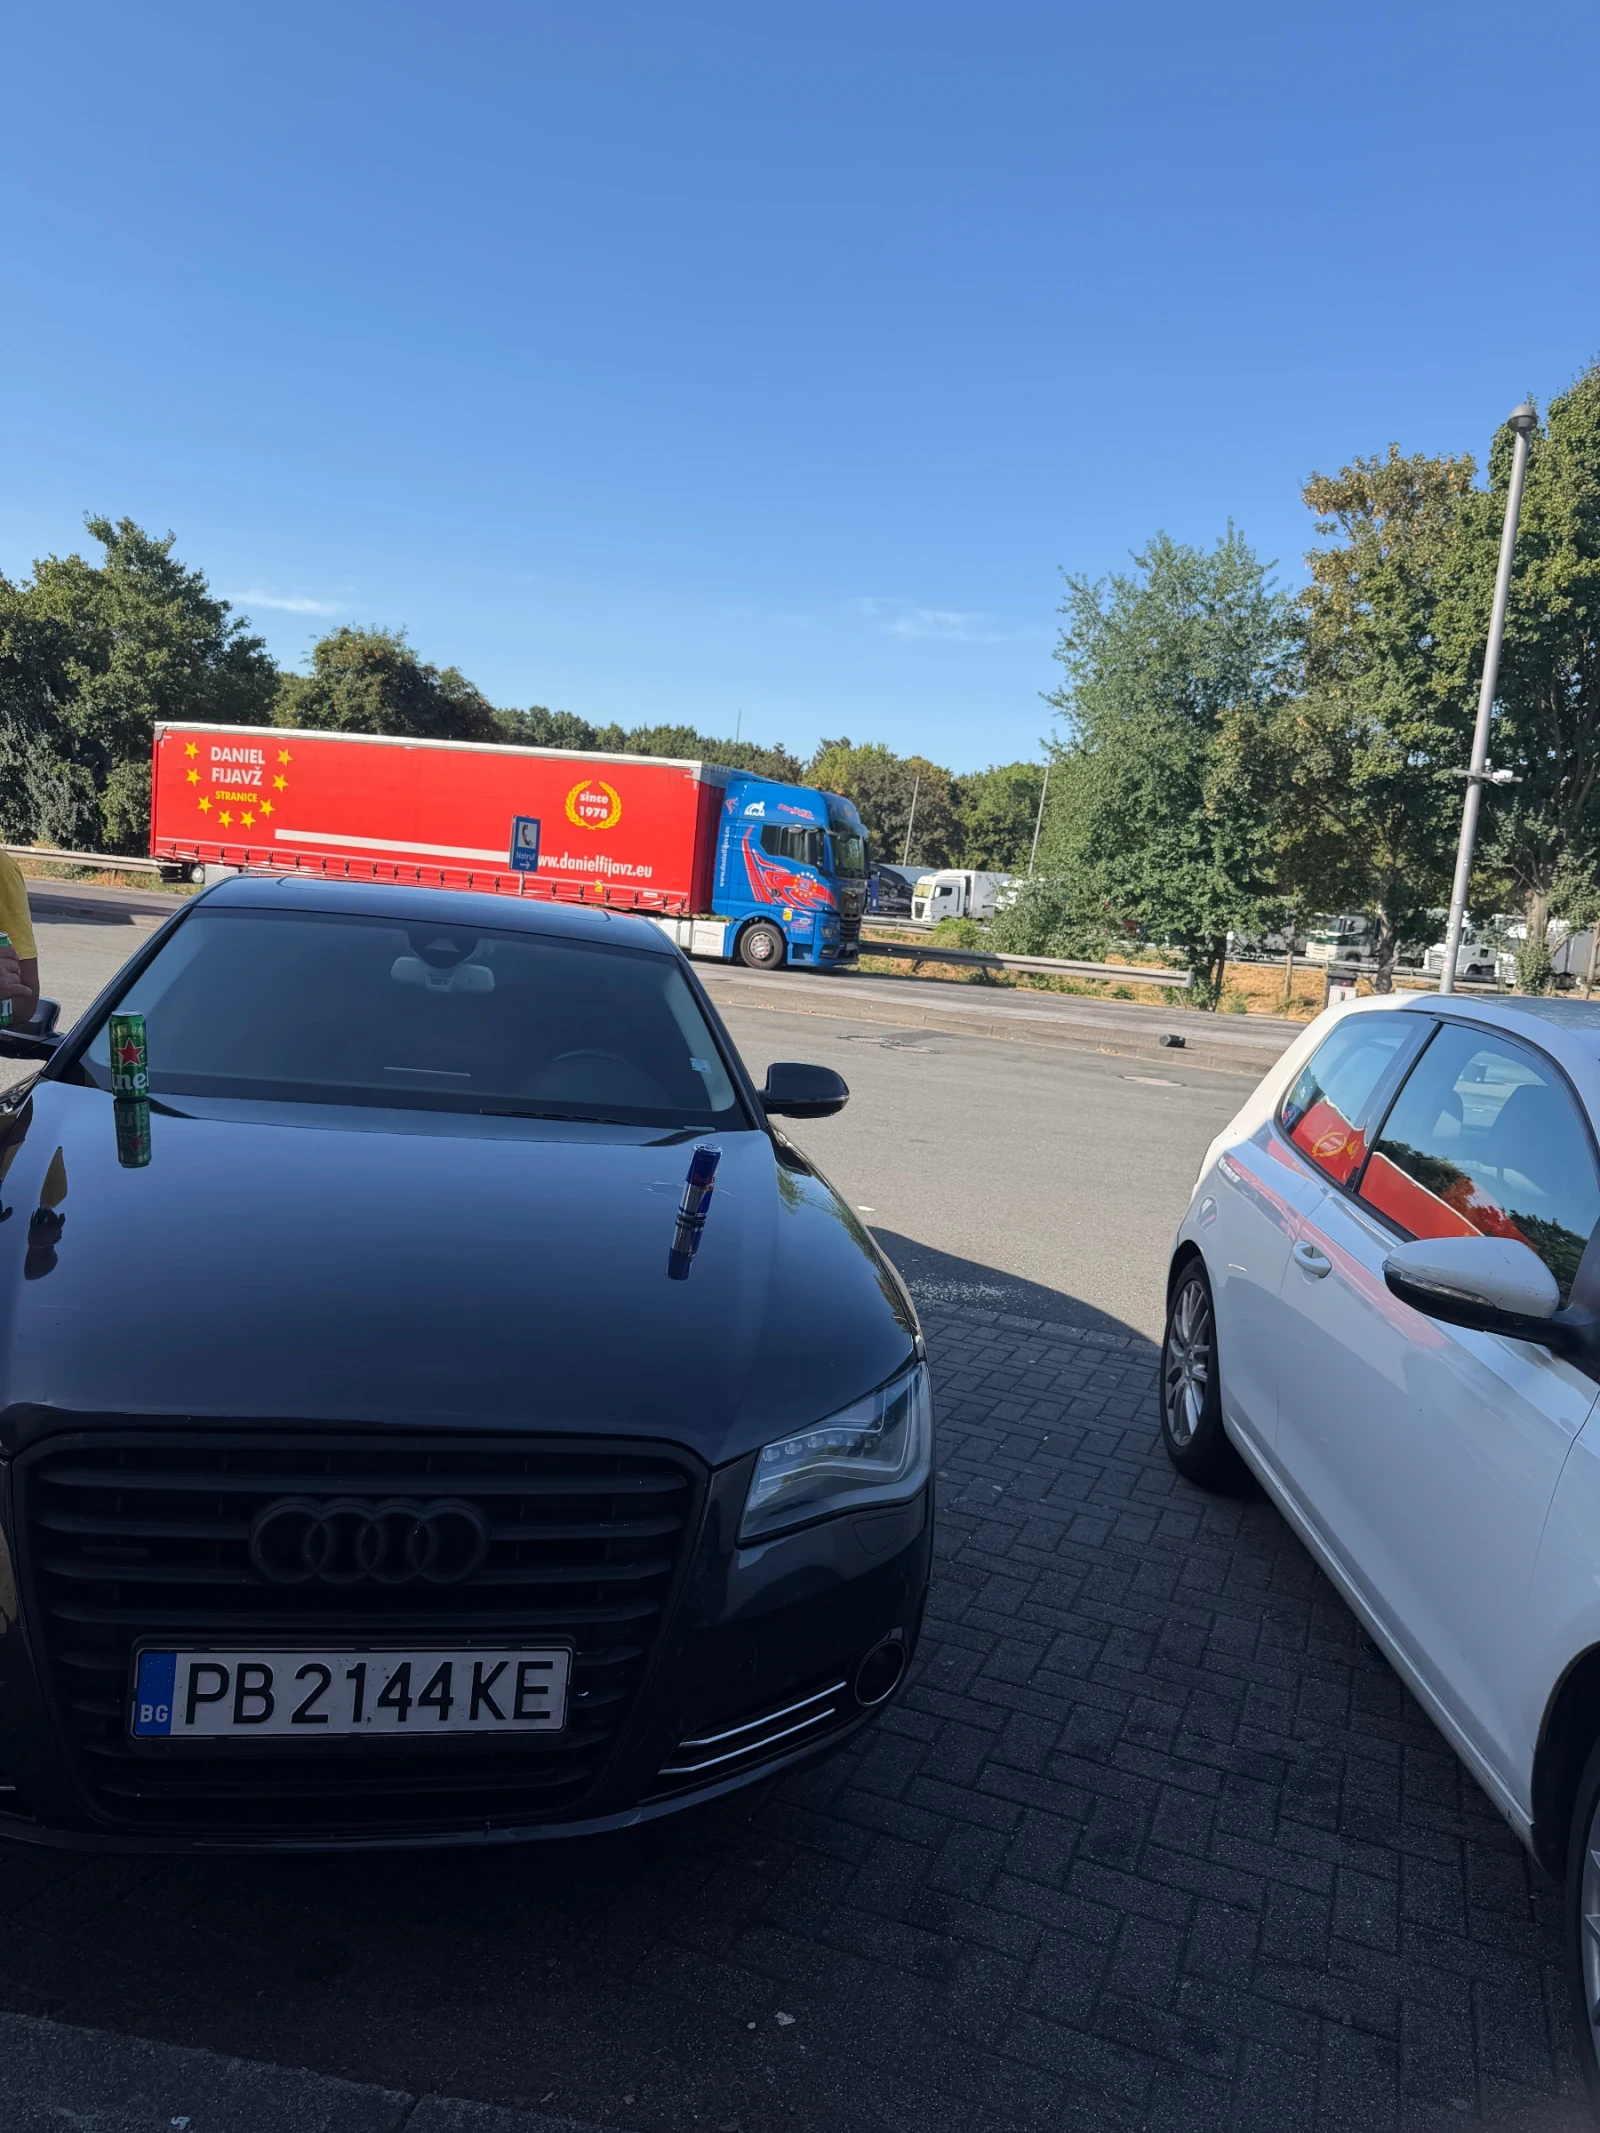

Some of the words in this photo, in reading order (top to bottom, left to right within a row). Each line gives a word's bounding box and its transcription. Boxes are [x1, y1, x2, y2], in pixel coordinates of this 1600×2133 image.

[211, 746, 266, 765] DANIEL
[211, 766, 263, 786] FIJAVŽ
[215, 790, 258, 803] STRANICE
[579, 791, 608, 804] since
[579, 806, 608, 819] 1978
[515, 851, 536, 861] Notruf
[538, 852, 652, 878] ww.danielfijavz.eu
[185, 1662, 275, 1725] PB
[291, 1661, 454, 1724] 2144
[469, 1660, 554, 1721] KE
[139, 1705, 168, 1723] BG
